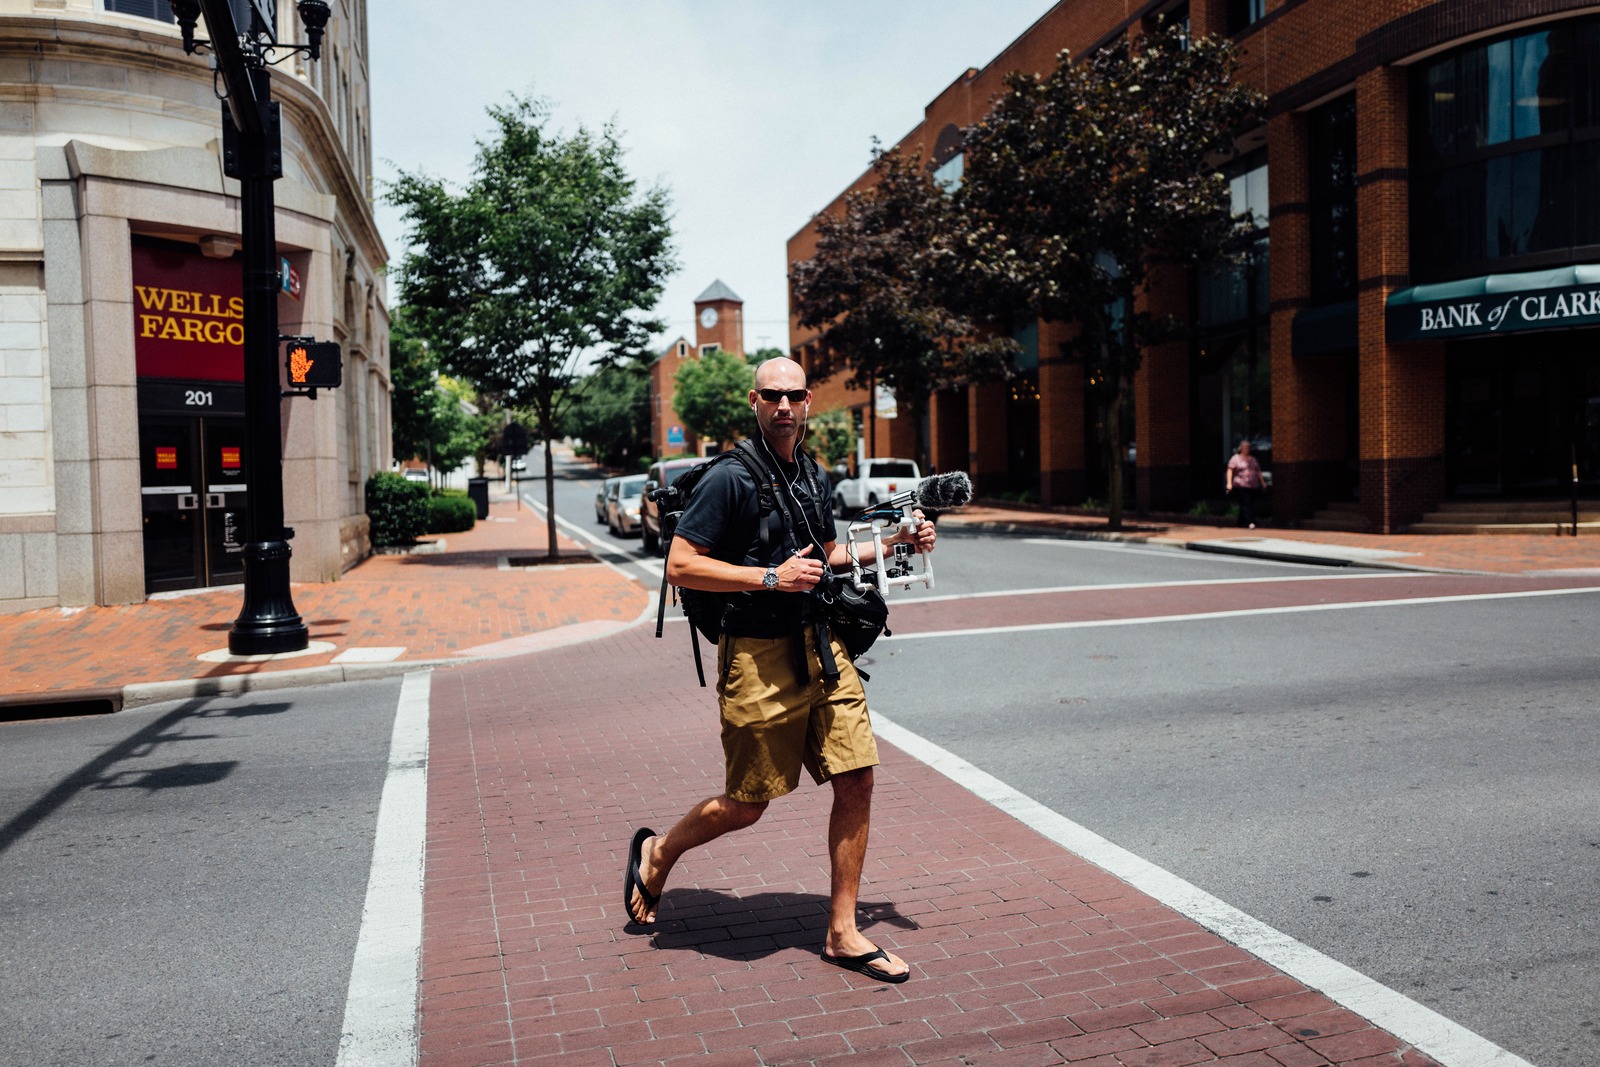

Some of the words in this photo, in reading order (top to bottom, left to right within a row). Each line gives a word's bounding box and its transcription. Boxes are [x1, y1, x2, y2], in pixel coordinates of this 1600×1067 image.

[134, 285, 243, 319] WELLS
[1420, 302, 1482, 331] BANK
[1487, 295, 1519, 331] of
[1520, 290, 1600, 321] CLARK
[140, 314, 244, 345] FARGO
[185, 390, 212, 406] 201
